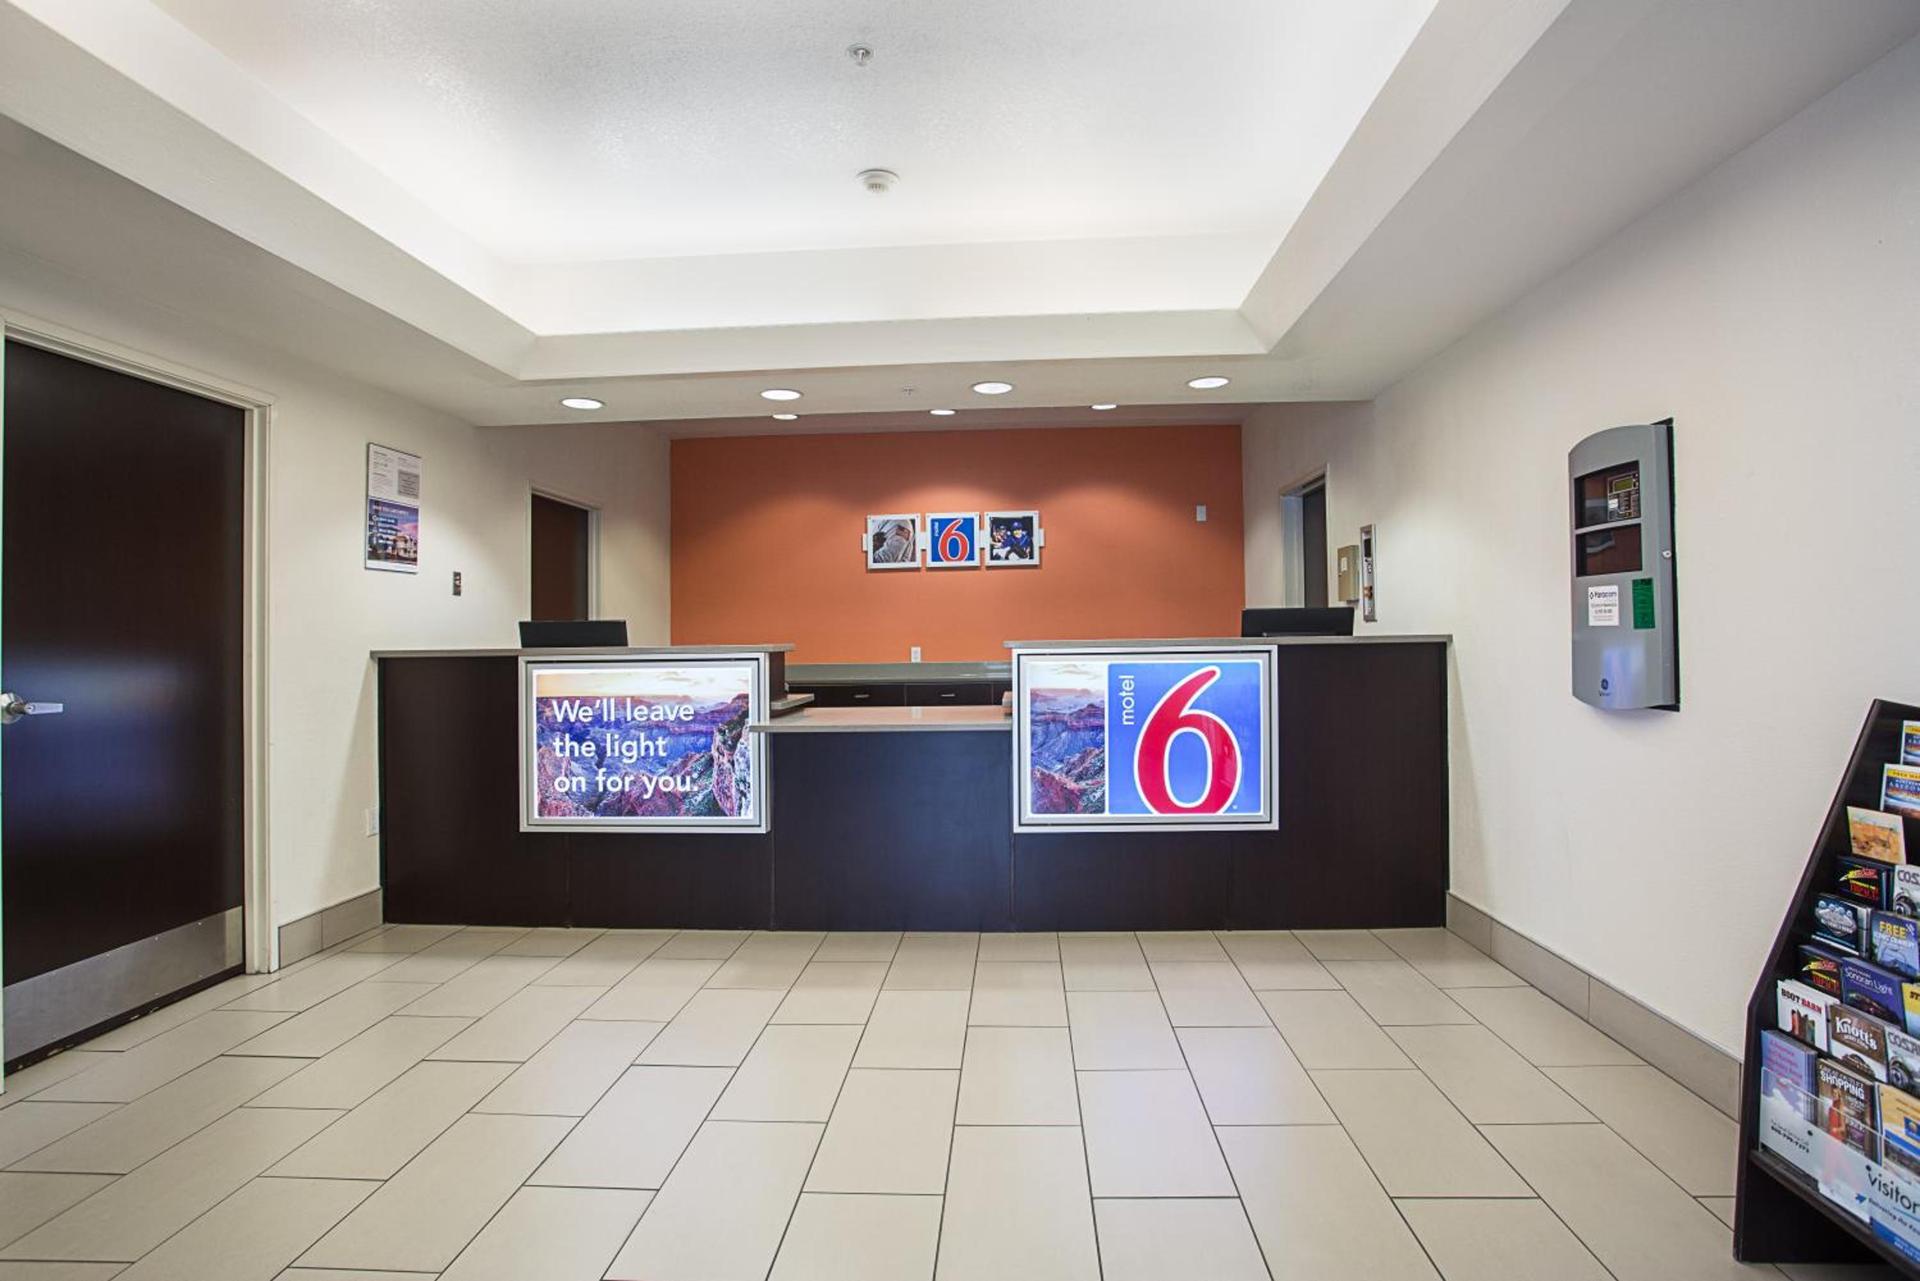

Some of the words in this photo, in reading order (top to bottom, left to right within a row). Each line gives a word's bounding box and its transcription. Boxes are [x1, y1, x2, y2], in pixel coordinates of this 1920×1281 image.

[938, 518, 969, 562] 6
[551, 697, 615, 723] We'll
[626, 697, 695, 722] leave
[1119, 675, 1135, 725] motel
[553, 736, 596, 758] the
[605, 732, 667, 763] light
[1133, 665, 1242, 815] 6
[553, 773, 586, 793] on
[595, 768, 632, 792] for
[643, 773, 699, 799] you.
[1879, 920, 1907, 939] FREE
[1781, 987, 1800, 1003] BOOT
[1835, 1016, 1877, 1050] Knott's
[1820, 1070, 1865, 1100] SHOPPING
